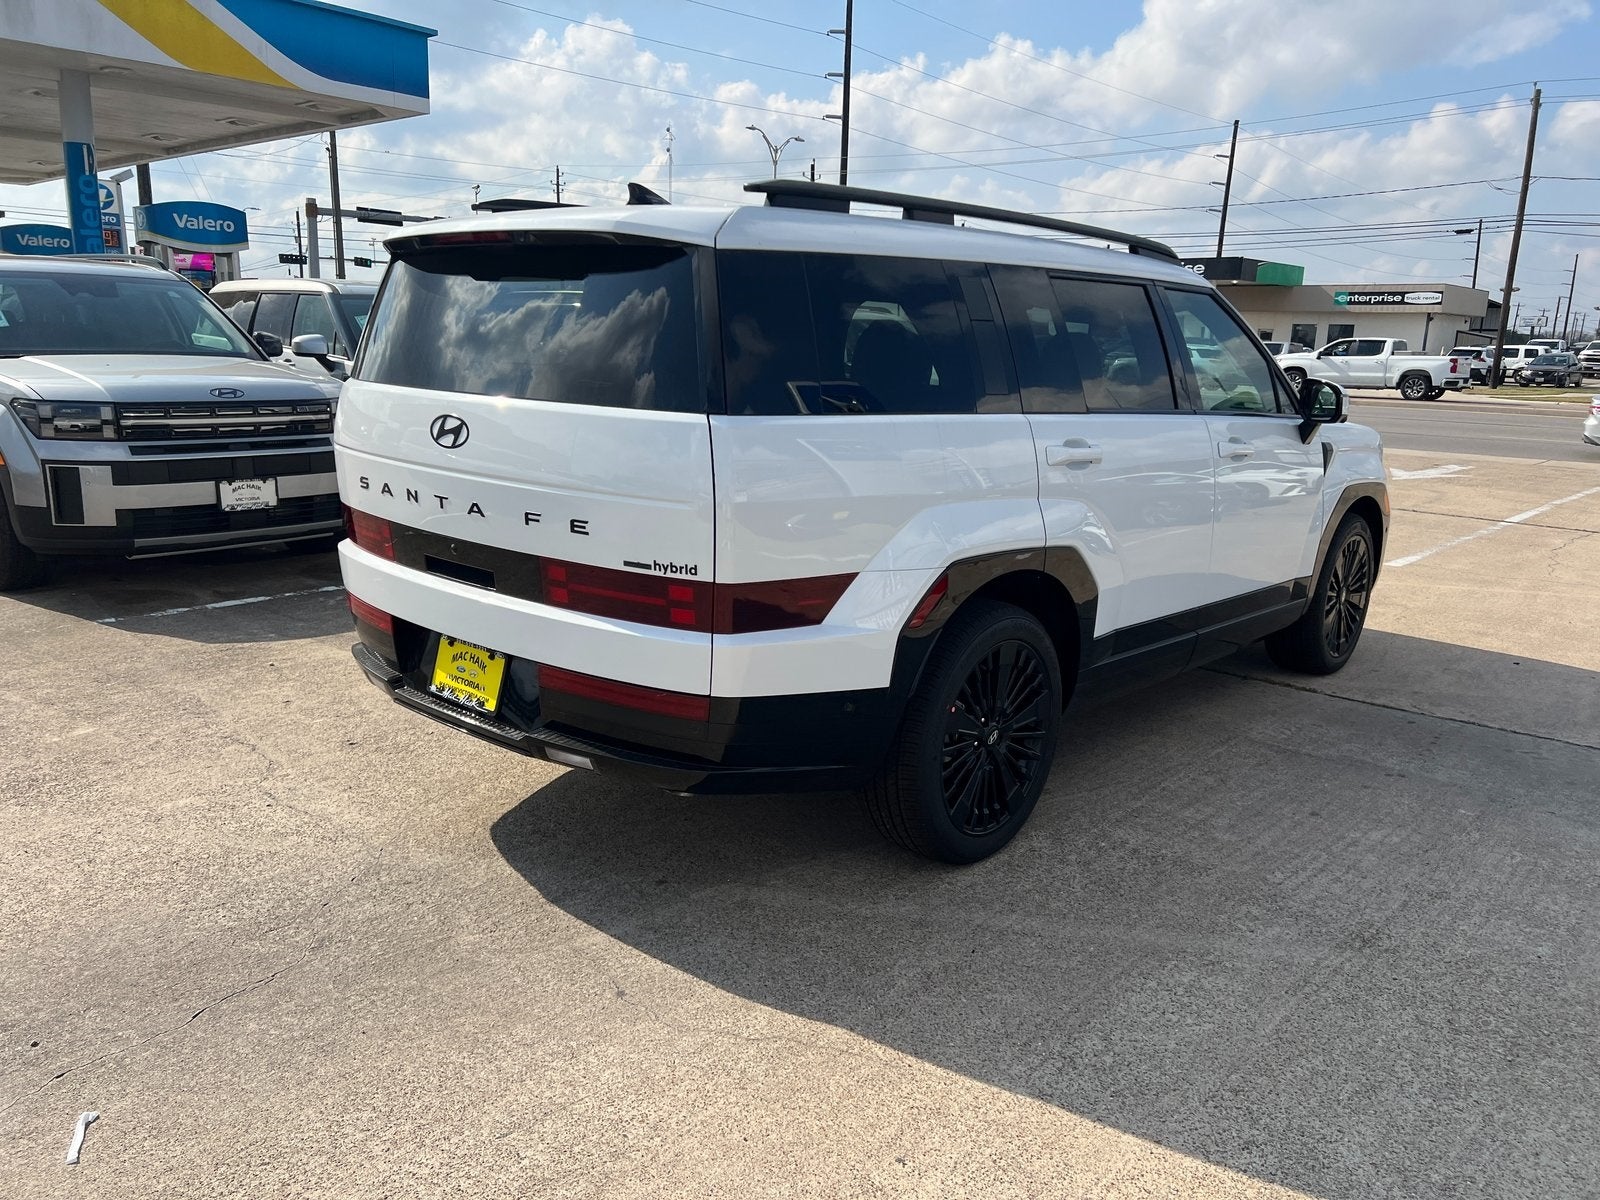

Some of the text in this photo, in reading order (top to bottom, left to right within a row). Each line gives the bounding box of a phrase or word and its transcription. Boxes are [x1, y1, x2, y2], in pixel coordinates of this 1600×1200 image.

[172, 212, 235, 233] Valero
[16, 233, 71, 248] Valero
[1335, 293, 1403, 304] enterprise
[359, 475, 589, 536] SANTA FE
[653, 559, 698, 576] hybrid
[451, 651, 487, 675] MAC HAIK
[452, 675, 480, 691] VICTORIA
